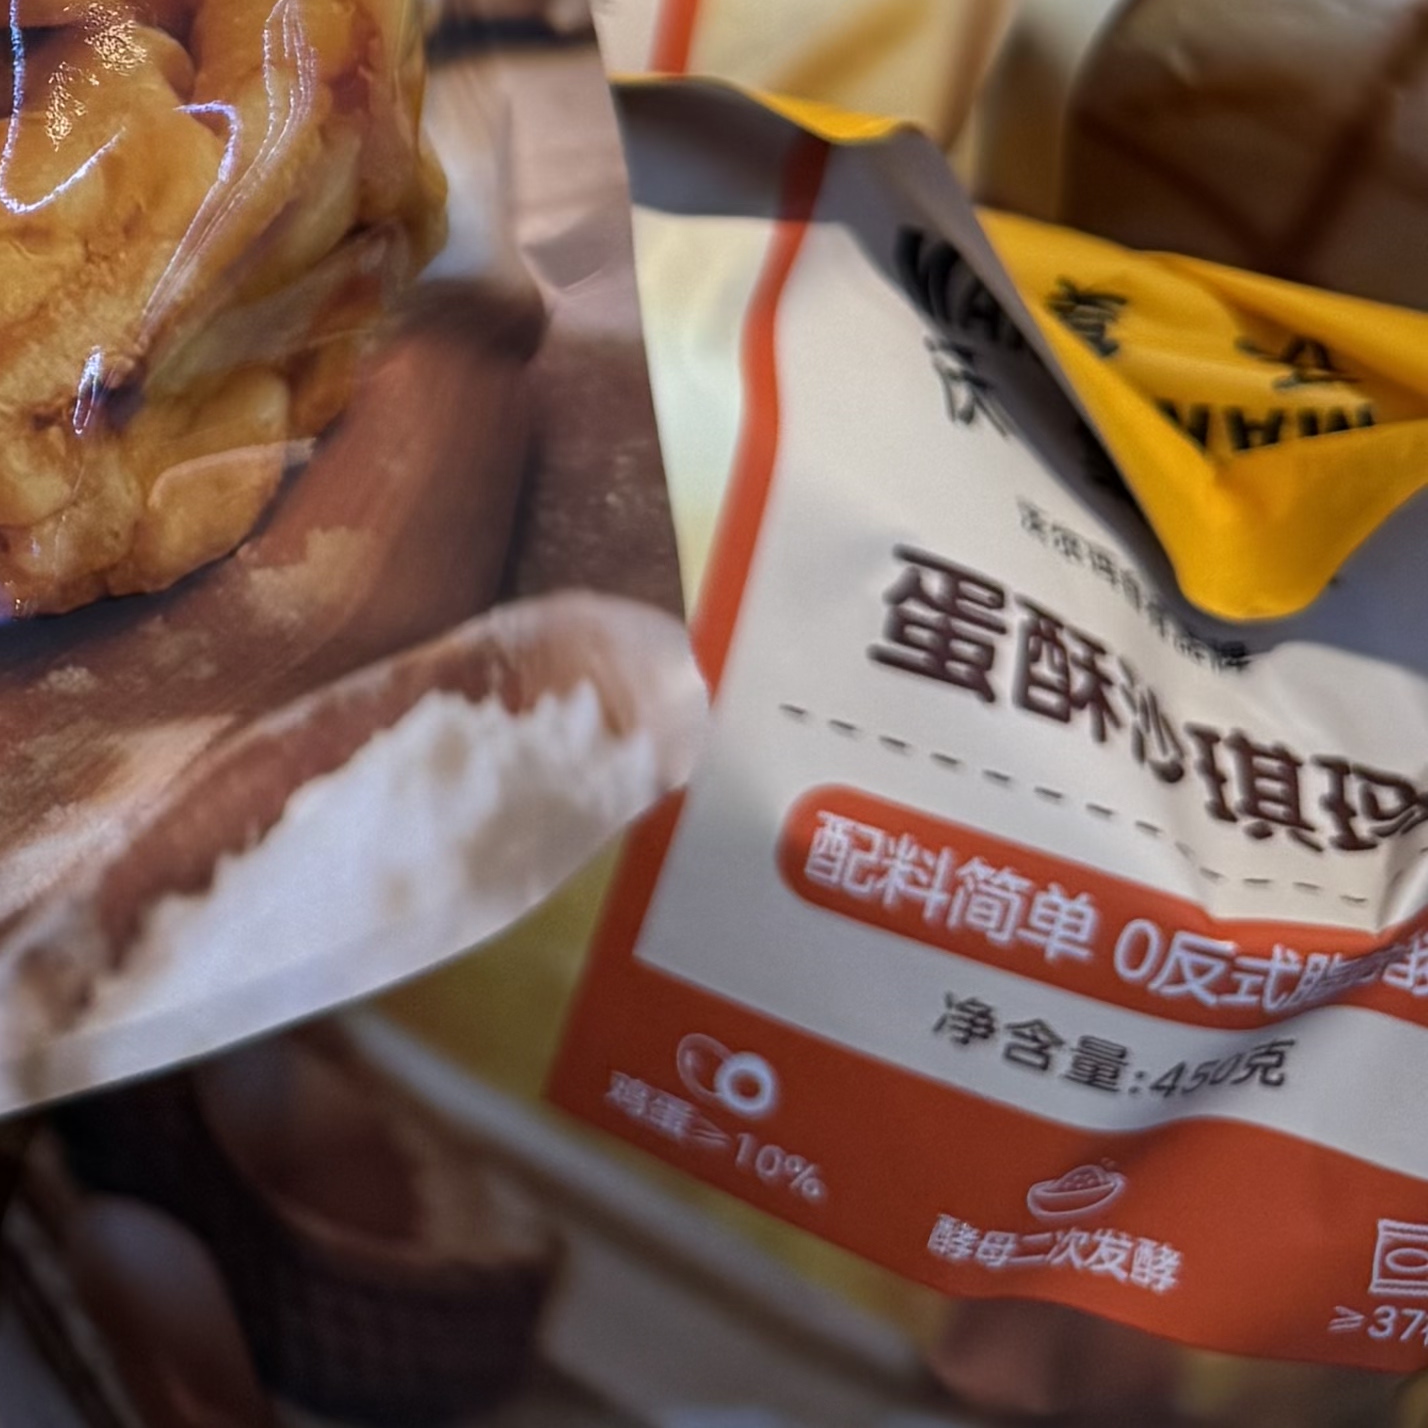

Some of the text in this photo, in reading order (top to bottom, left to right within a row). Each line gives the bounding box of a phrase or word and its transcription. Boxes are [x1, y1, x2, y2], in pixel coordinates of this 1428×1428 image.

[803, 809, 1428, 1013] 配料简单 0反式
[931, 991, 1297, 1100] 净含量:450克
[927, 1212, 1183, 1295] 酵母二次发酵
[1327, 1303, 1428, 1348] ≥37
